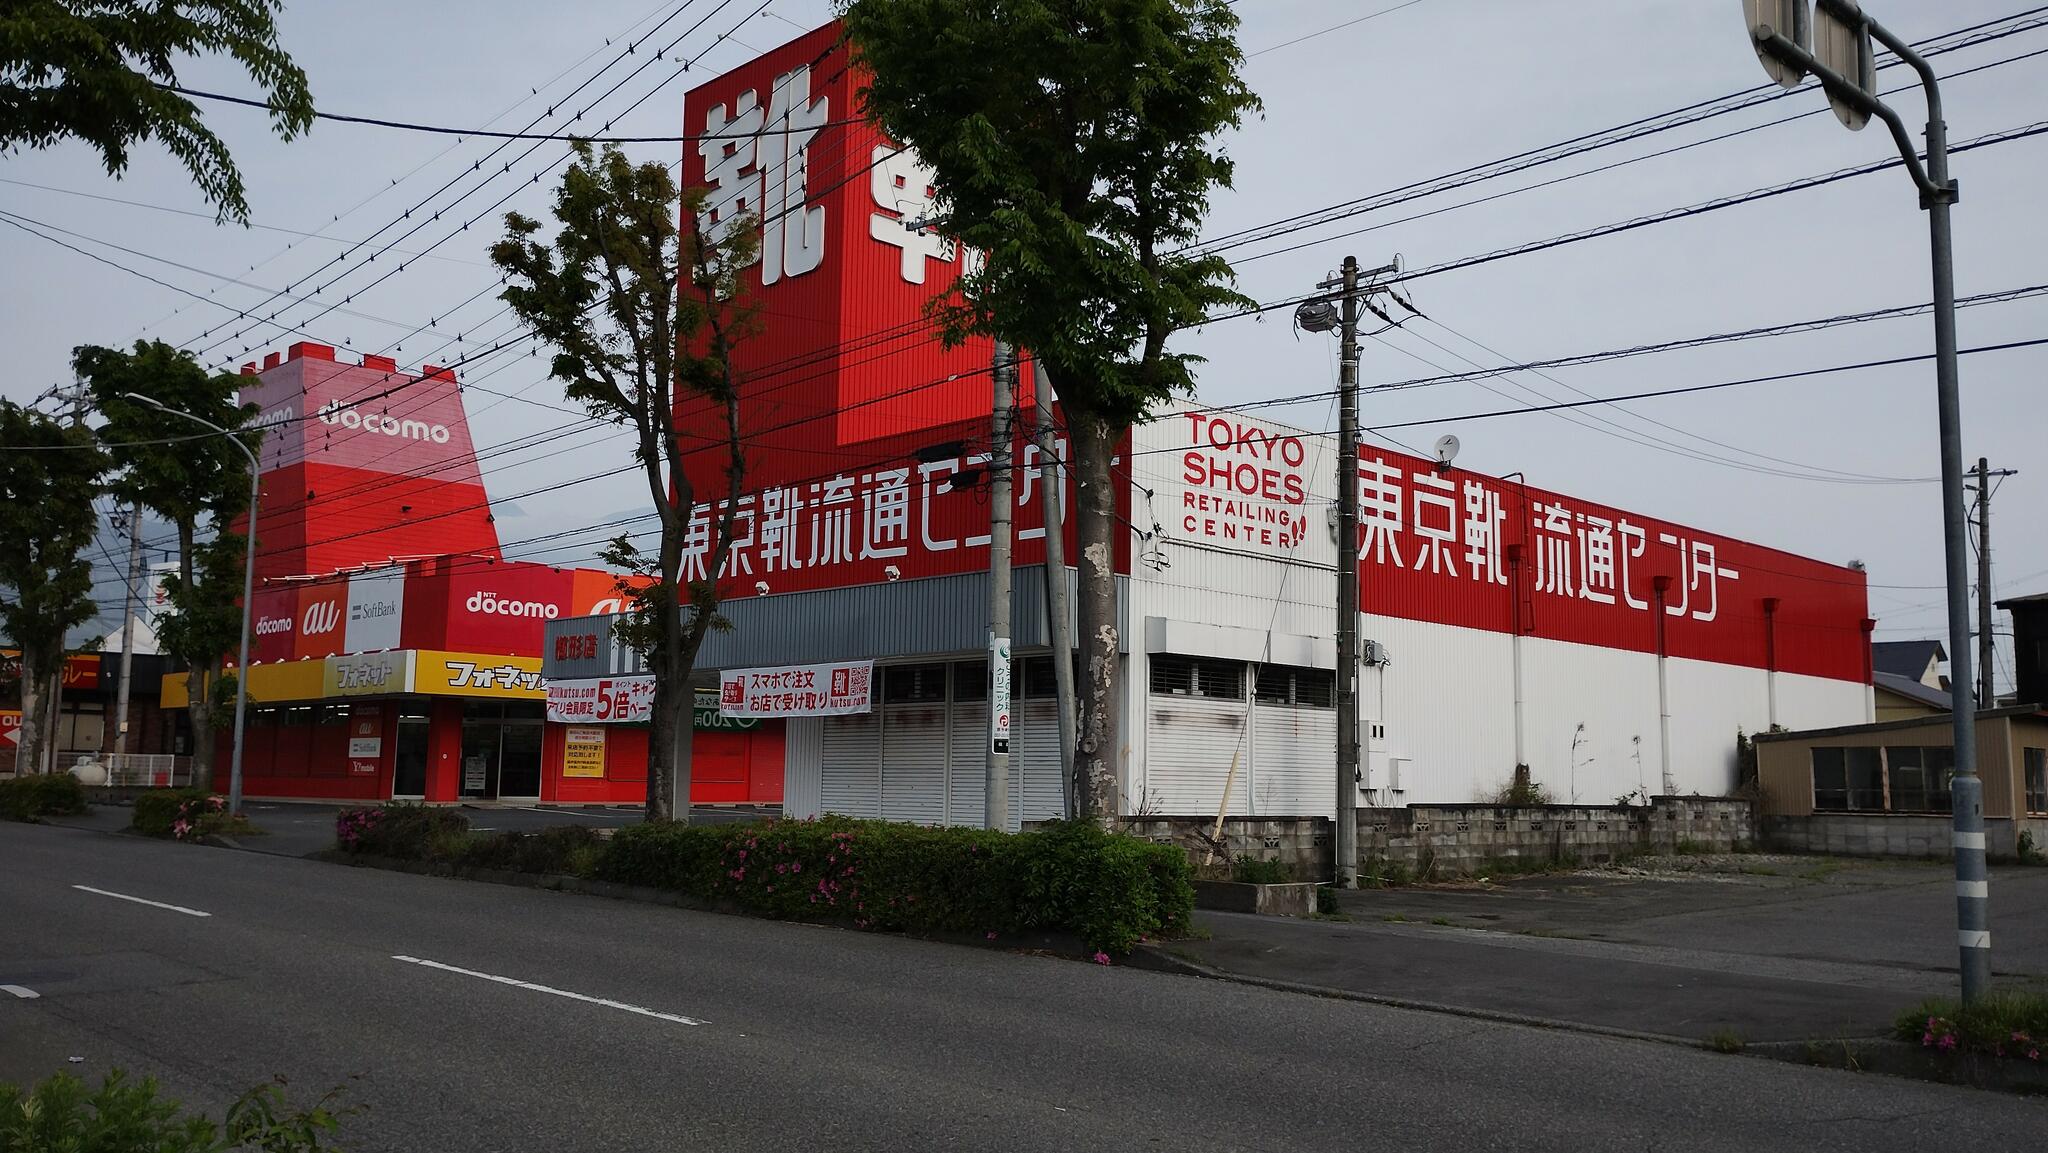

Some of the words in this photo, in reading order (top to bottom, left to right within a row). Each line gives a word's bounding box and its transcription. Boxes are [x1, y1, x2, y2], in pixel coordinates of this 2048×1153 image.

[692, 63, 829, 303] 靴
[240, 406, 293, 432] ocomo
[317, 399, 450, 444] docomo
[1184, 411, 1304, 467] TOKYO
[1184, 452, 1304, 505] SHOES
[1184, 491, 1290, 526] RETAILING
[1359, 457, 1739, 622] 東京靴流通センター
[303, 600, 340, 635] au
[363, 601, 397, 620] SoftBank
[466, 591, 559, 619] docomo
[255, 617, 292, 636] docomo
[337, 660, 392, 688] フォネット
[751, 670, 815, 689] スマホで注文
[834, 672, 847, 694] 靴
[750, 691, 828, 712] お店で受け取り
[996, 668, 1005, 711] クリニック
[2, 716, 23, 726] OU
[630, 702, 654, 715] ペー
